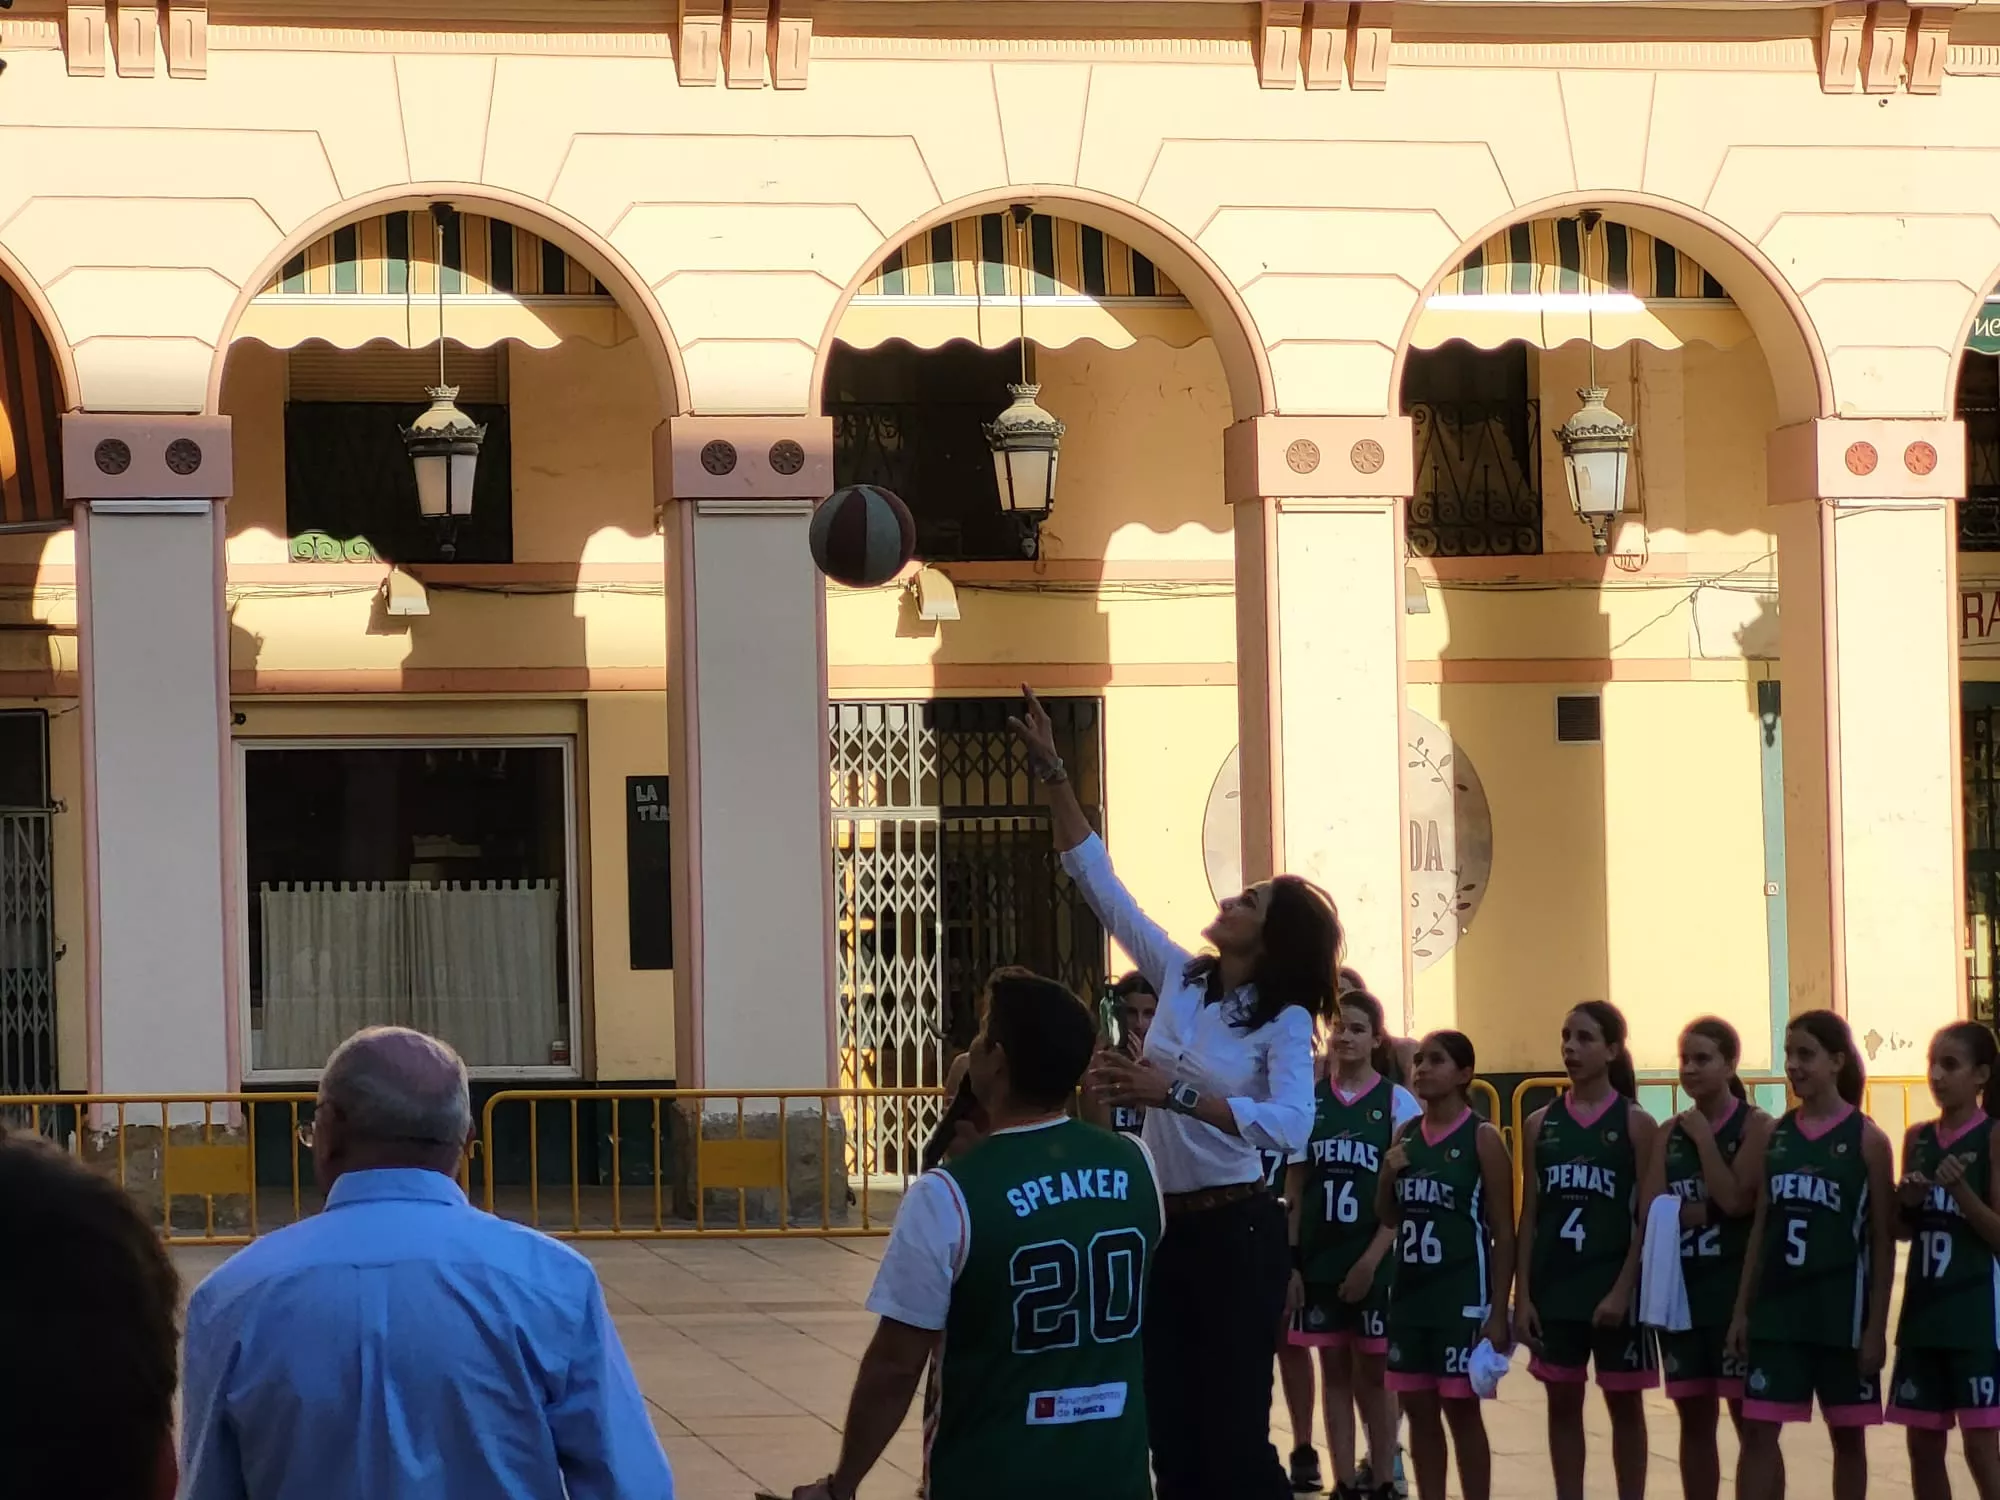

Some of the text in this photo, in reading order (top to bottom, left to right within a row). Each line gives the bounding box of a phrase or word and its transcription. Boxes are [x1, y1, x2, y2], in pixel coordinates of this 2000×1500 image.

[635, 784, 658, 802] LA
[1006, 1168, 1129, 1218] SPEAKER
[1323, 1180, 1359, 1223] 16
[1402, 1219, 1443, 1264] 26
[1560, 1207, 1587, 1253] 4
[1785, 1219, 1808, 1266] 5
[1920, 1230, 1953, 1278] 19
[1008, 1227, 1147, 1354] 20
[1362, 1310, 1384, 1336] 16
[1445, 1346, 1470, 1373] 26
[1623, 1341, 1638, 1368] 4
[1968, 1376, 1995, 1407] 19
